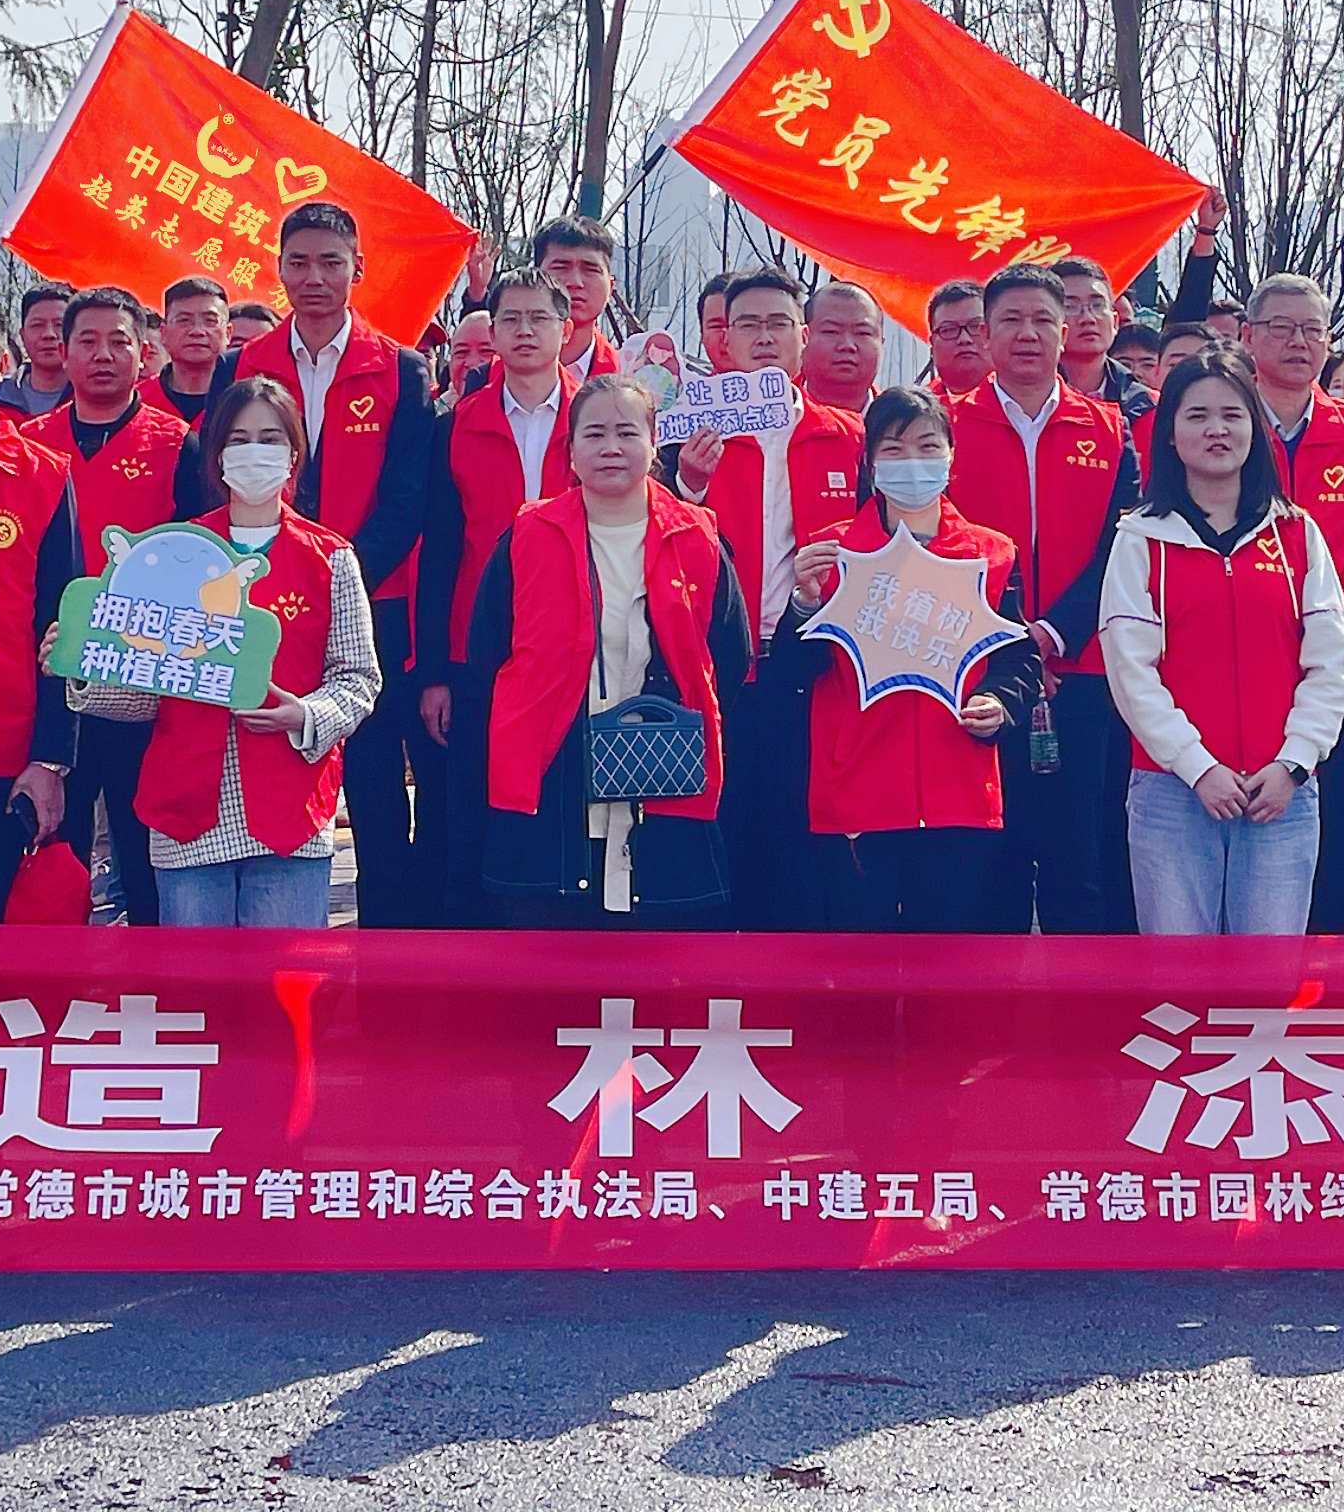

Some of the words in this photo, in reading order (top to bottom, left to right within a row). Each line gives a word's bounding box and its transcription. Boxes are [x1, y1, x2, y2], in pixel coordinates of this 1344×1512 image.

[685, 372, 785, 406] 让我们
[90, 592, 245, 655] 拥抱春天
[855, 605, 956, 670] 我快乐
[868, 572, 973, 640] 我植树
[80, 640, 236, 704] 种植希望
